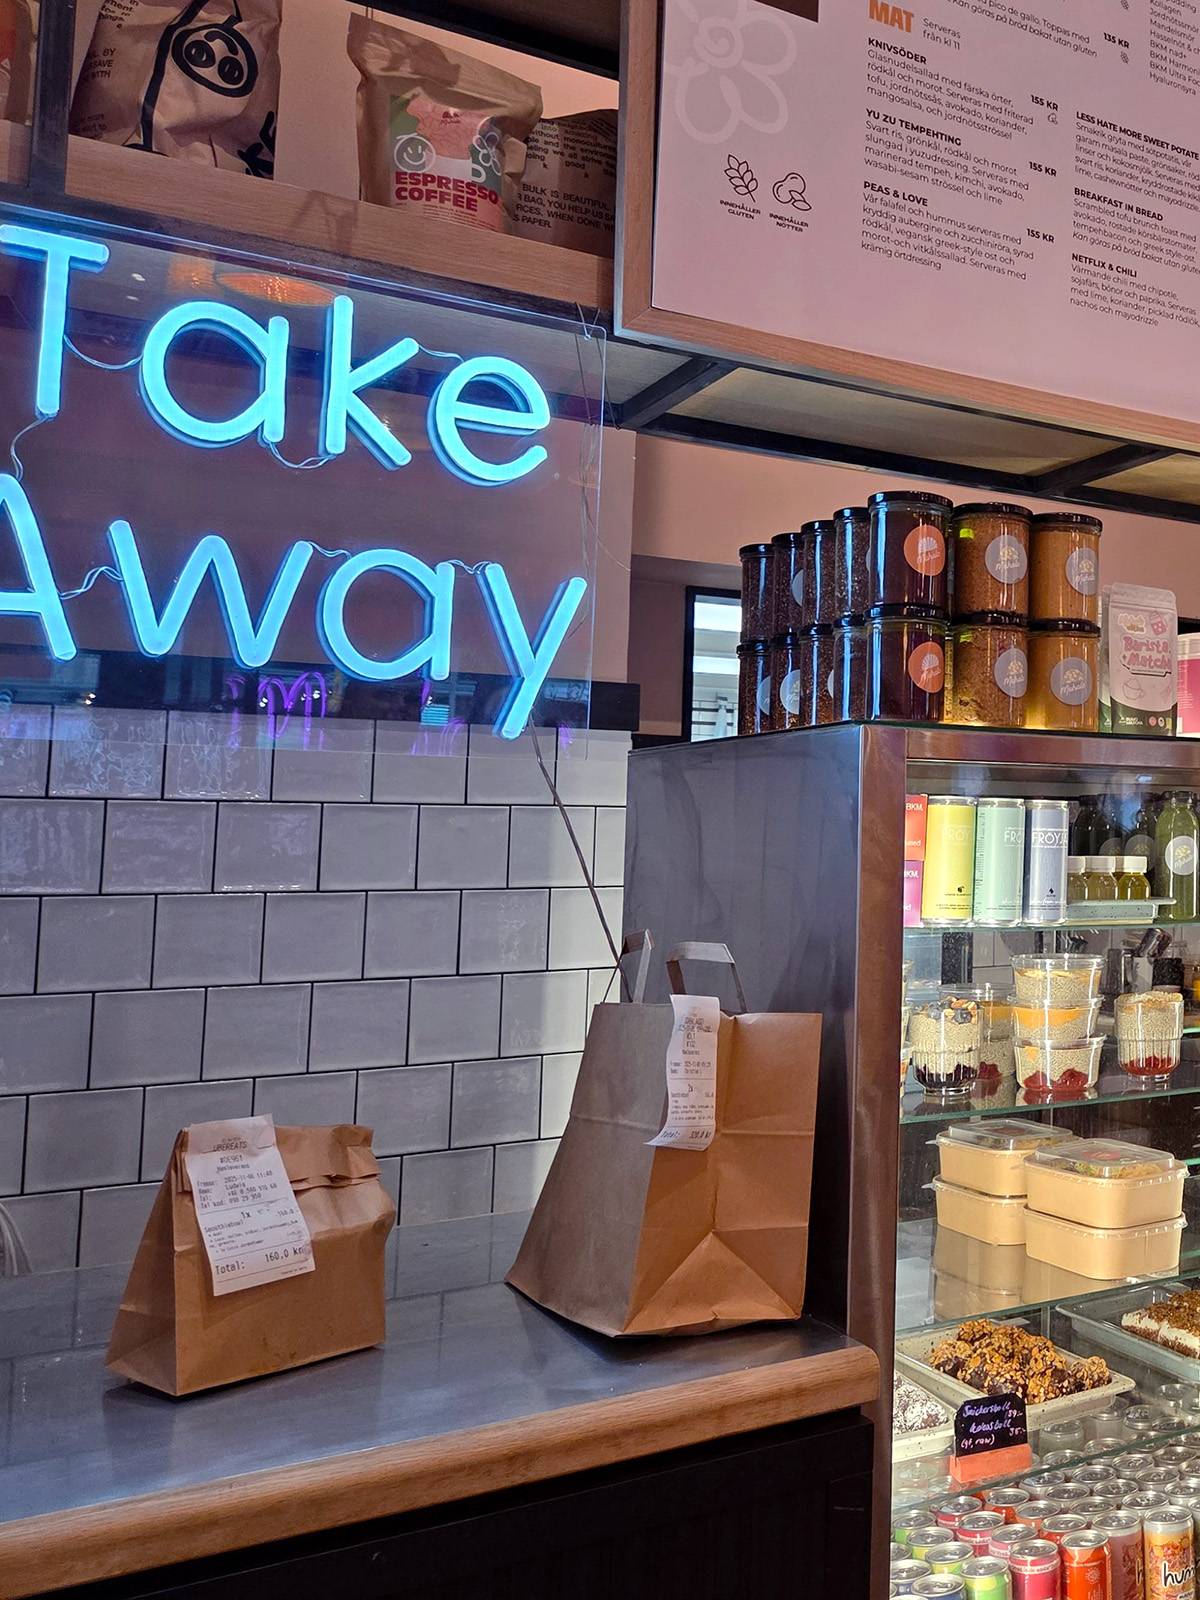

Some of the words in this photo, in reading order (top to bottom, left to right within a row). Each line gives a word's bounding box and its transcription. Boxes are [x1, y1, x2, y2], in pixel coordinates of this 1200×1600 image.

[869, 0, 914, 33] MAT
[1149, 7, 1199, 34] Jordnötssmör
[923, 20, 962, 38] Serveras
[1149, 18, 1195, 42] Mandelsmör
[868, 37, 927, 63] KNIVSÖDER
[922, 31, 942, 44] från
[943, 37, 952, 47] kl
[954, 40, 961, 50] 11
[103, 48, 116, 57] BY
[1149, 50, 1168, 63] BKM
[867, 50, 940, 81] Glasnudelsallad
[941, 77, 962, 89] med
[963, 82, 990, 98] färska
[990, 92, 1014, 108] örter,
[1149, 61, 1168, 74] BKM
[1168, 68, 1187, 81] Ultra
[867, 63, 896, 78] rödkål
[897, 74, 915, 84] och
[915, 80, 945, 95] morot.
[946, 88, 982, 107] Serveras
[982, 103, 1003, 114] med
[1003, 108, 1034, 125] friterad
[1031, 94, 1045, 106] 155
[1046, 100, 1059, 111] KR
[866, 108, 880, 119] YU
[882, 113, 897, 125] ZU
[898, 118, 962, 146] TEMPEHTING
[1076, 111, 1096, 124] LESS
[1096, 118, 1118, 132] HATE
[1118, 126, 1143, 140] MORE
[1143, 134, 1170, 150] SWEET
[1029, 161, 1043, 172] 155
[1044, 166, 1057, 177] KR
[395, 171, 499, 205] ESPRESSO
[523, 184, 547, 196] BULK
[551, 190, 559, 198] IS
[863, 180, 891, 195] PEAS
[892, 189, 900, 198] &
[902, 192, 928, 206] LOVE
[395, 187, 478, 212] COFFEE
[547, 200, 566, 210] YOU
[568, 203, 590, 215] HELP
[592, 209, 603, 219] US
[720, 200, 761, 215] INNEHÅLLER
[1074, 187, 1123, 208] BREAKFAST
[1124, 203, 1134, 212] IN
[1135, 206, 1164, 221] BREAD
[547, 210, 573, 222] WHEN
[577, 217, 601, 229] DONE
[728, 209, 754, 220] GLUTEN
[769, 213, 809, 228] INNEHÅLLER
[1027, 228, 1041, 238] 155
[1042, 233, 1055, 242] KR
[1071, 253, 1106, 269] NETFLIX
[1107, 263, 1114, 271] &
[1115, 265, 1138, 277] CHILI
[0, 224, 551, 487] Take
[1123, 636, 1169, 653] Barista
[241, 1211, 252, 1219] 1x
[215, 1261, 245, 1275] Total:
[264, 1249, 289, 1262] 160.0
[292, 1247, 303, 1256] kr
